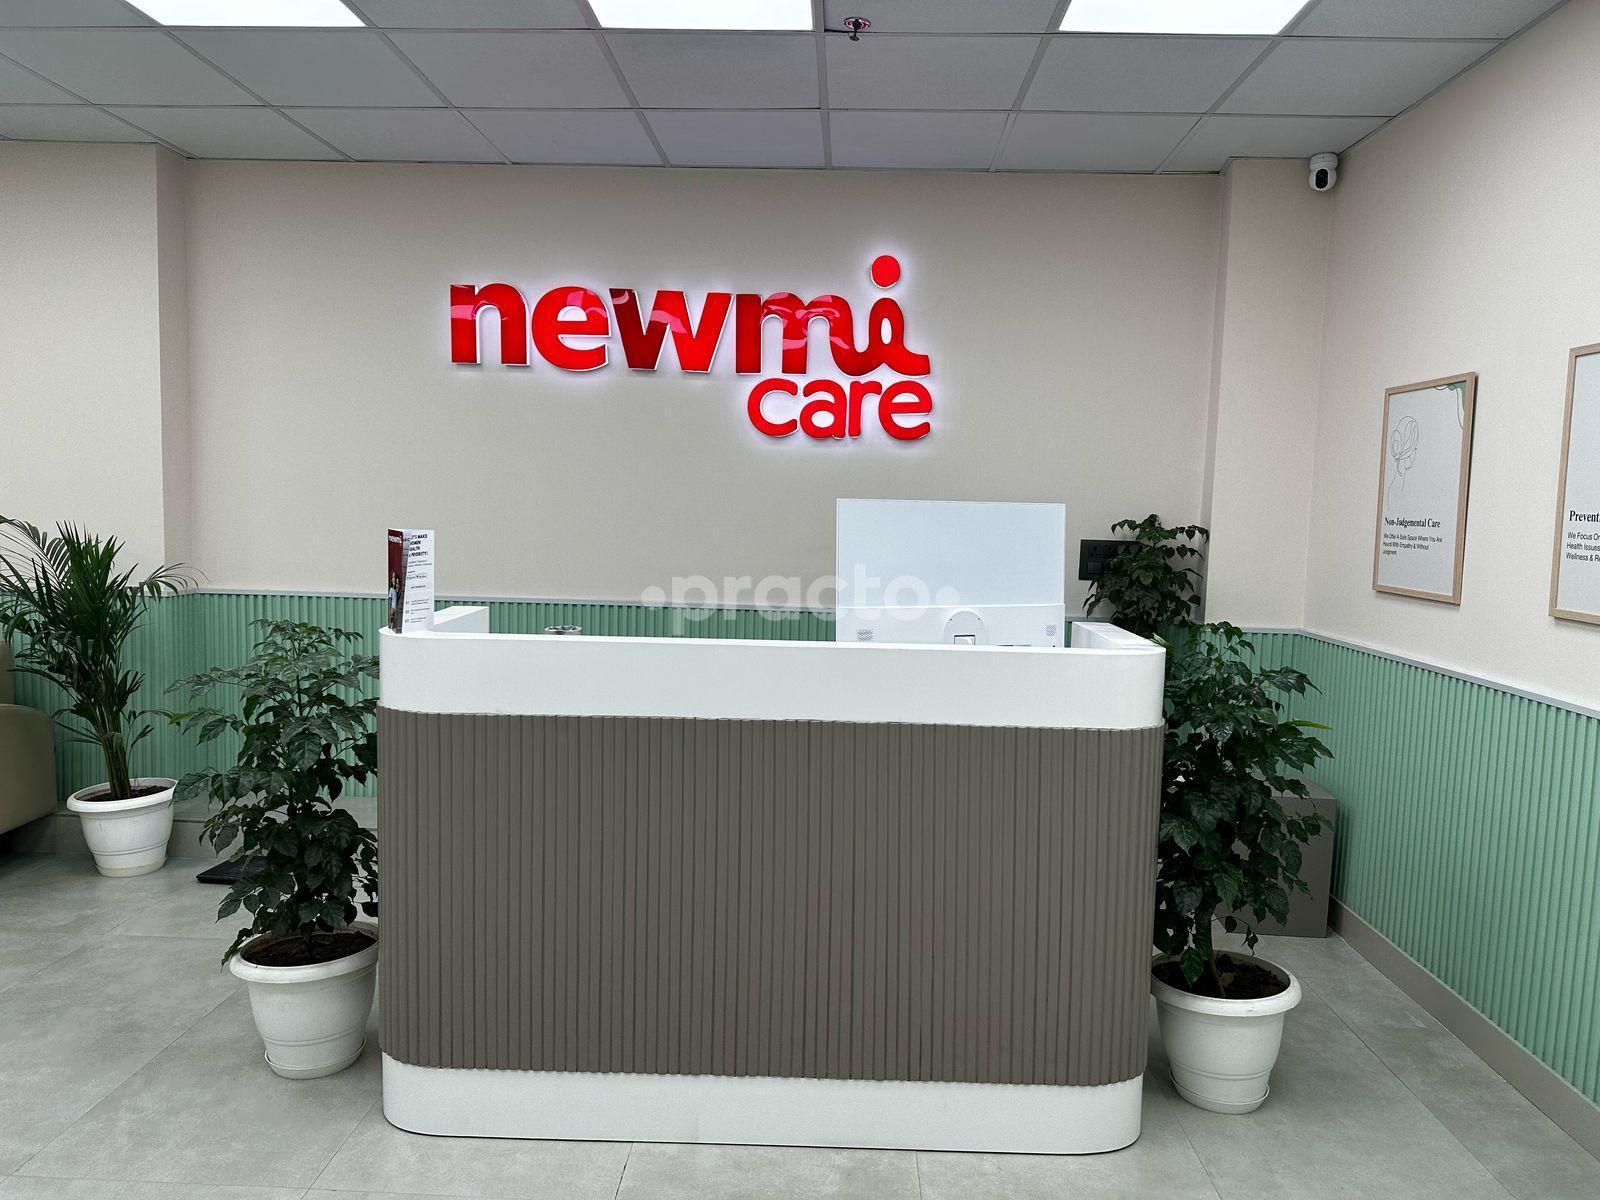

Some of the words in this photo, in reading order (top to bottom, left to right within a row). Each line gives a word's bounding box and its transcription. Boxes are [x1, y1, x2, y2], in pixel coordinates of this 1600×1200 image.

[450, 254, 931, 377] newmi
[747, 378, 933, 441] care
[1569, 510, 1600, 523] Prevent
[1384, 516, 1427, 529] Non-Judgemental
[1427, 518, 1441, 528] Care
[1407, 534, 1418, 542] Space
[1567, 531, 1577, 540] We
[1577, 532, 1593, 541] Focus
[1400, 542, 1412, 550] Empathy
[1566, 542, 1583, 550] Health
[1565, 551, 1588, 561] Wellness
[1589, 554, 1594, 562] &
